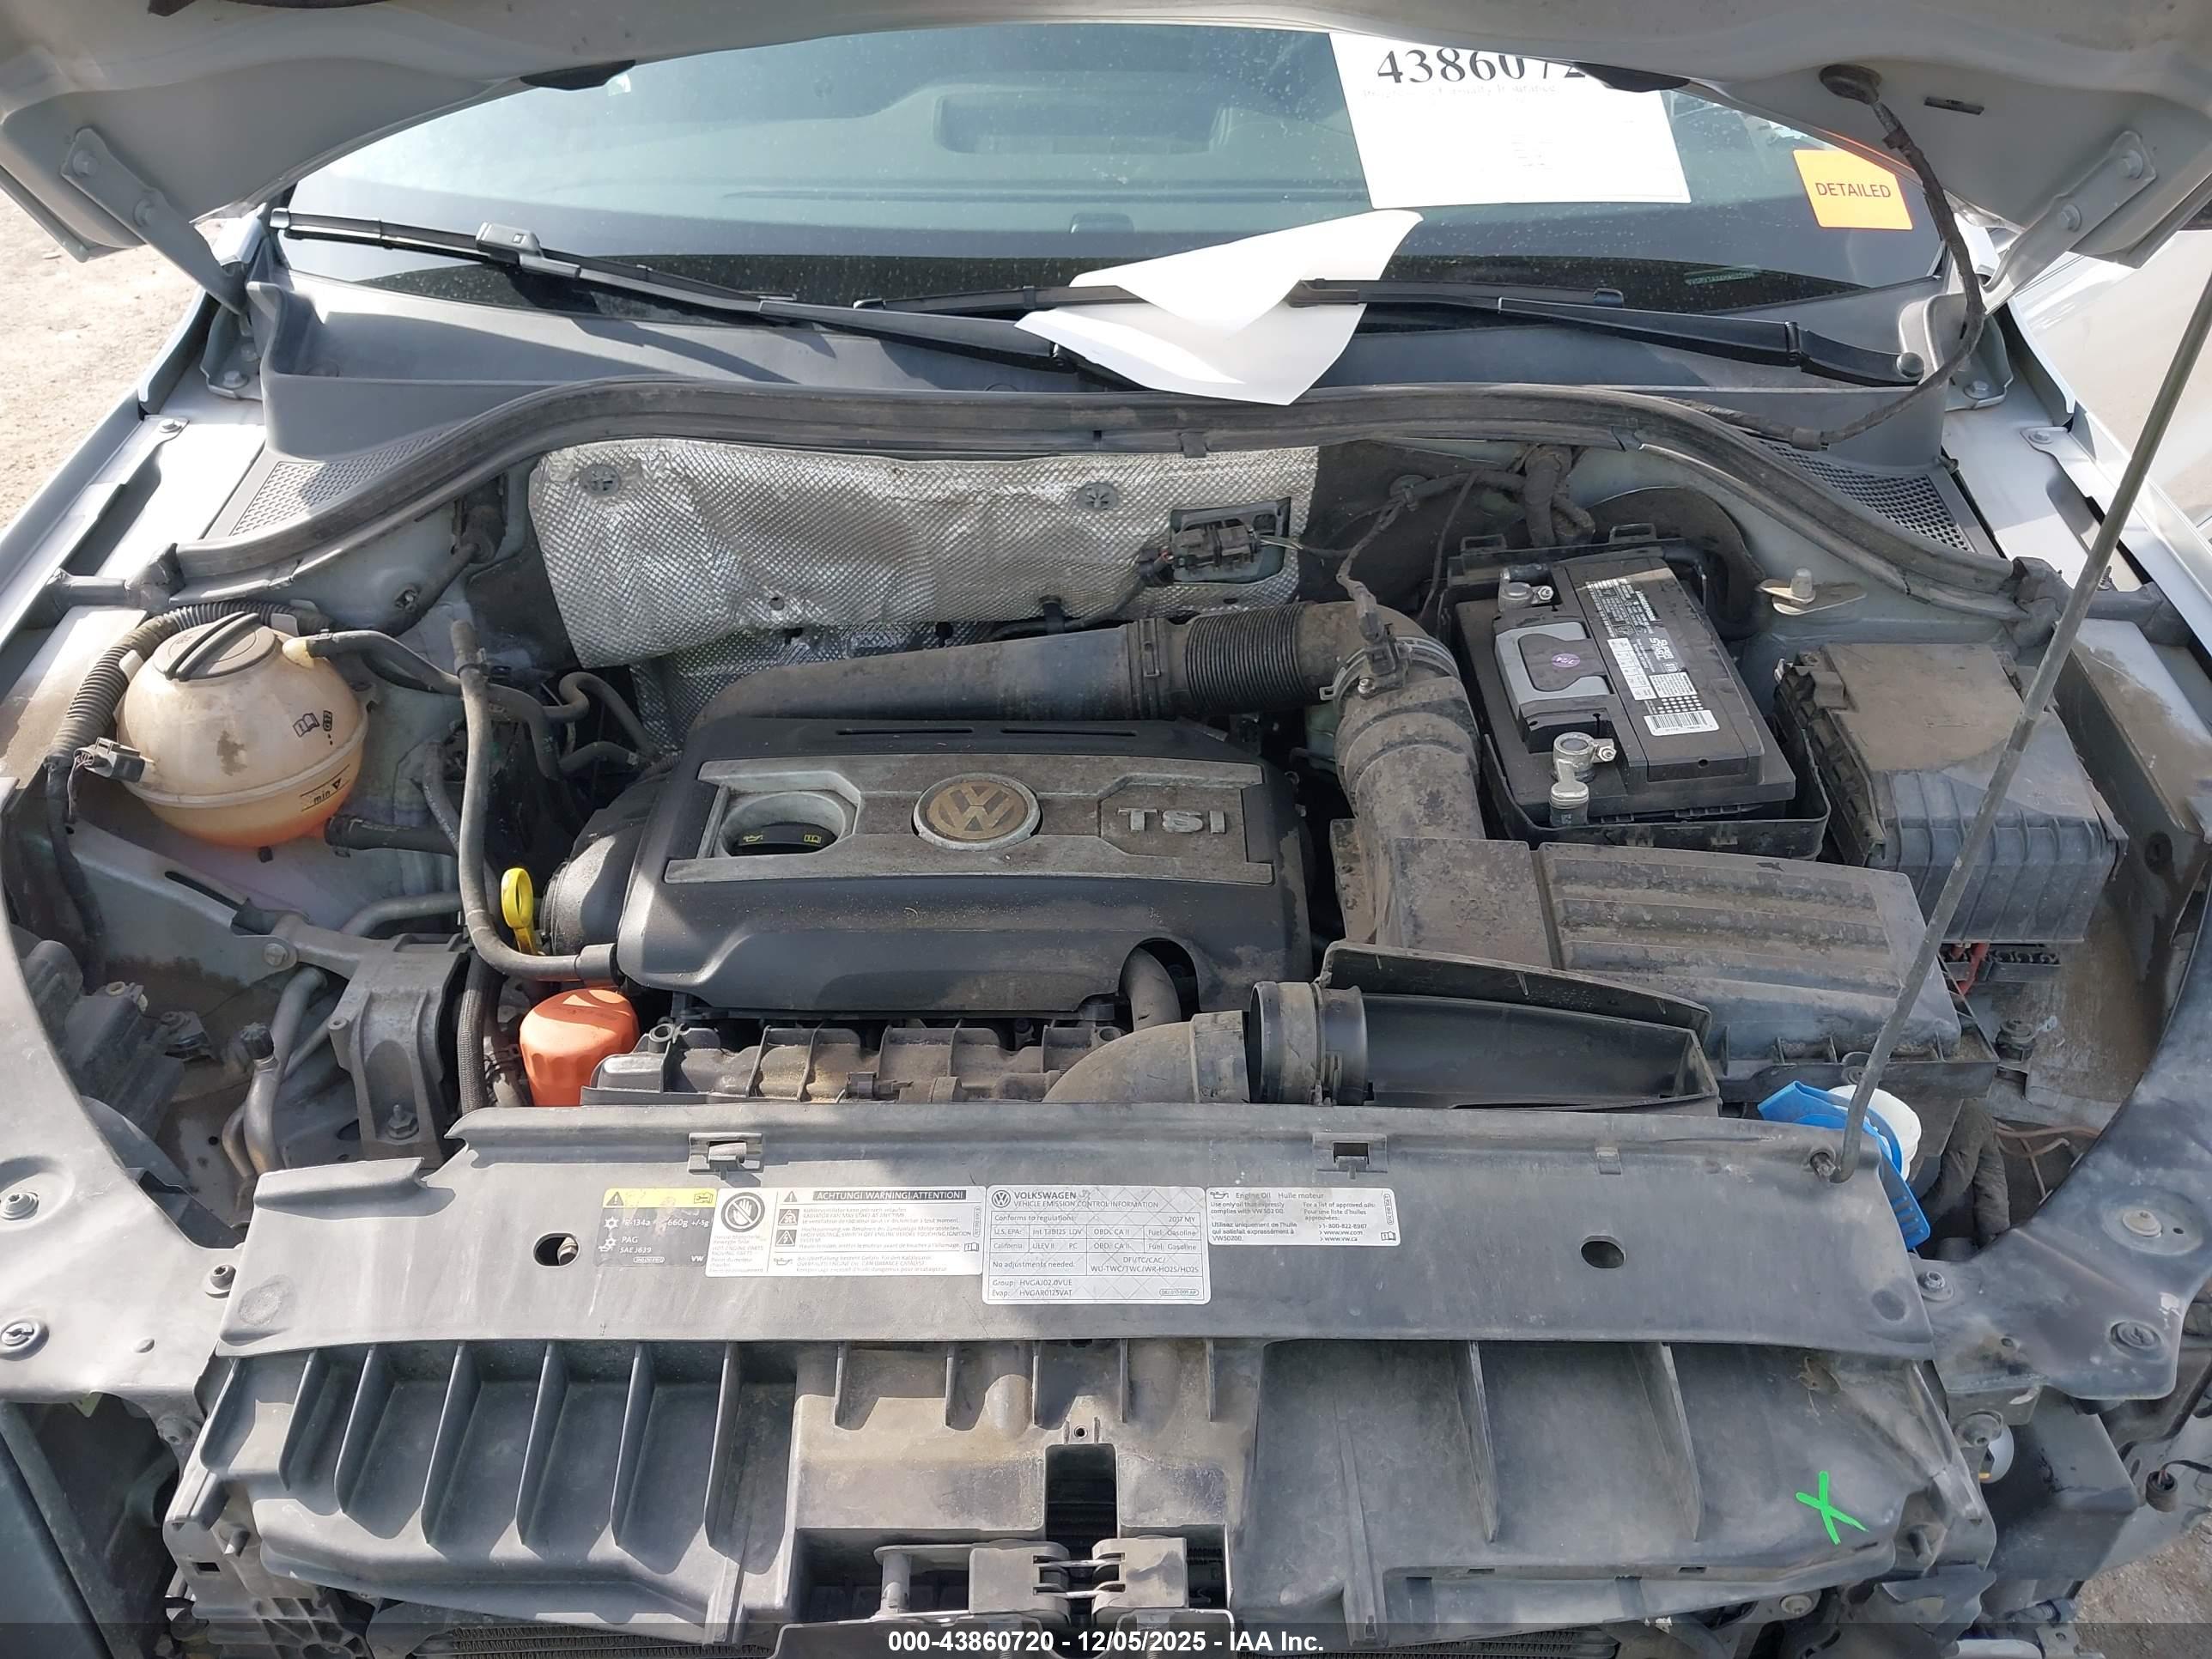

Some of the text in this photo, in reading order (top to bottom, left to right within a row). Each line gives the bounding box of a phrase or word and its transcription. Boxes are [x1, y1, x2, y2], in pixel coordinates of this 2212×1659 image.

[1814, 182, 1892, 198] DETAILED
[313, 790, 331, 805] min
[1116, 807, 1227, 836] TSI
[1014, 1191, 1077, 1200] VOLKSWAGEN
[1236, 1192, 1260, 1200] Engine
[667, 1218, 689, 1228] 660g
[621, 1236, 639, 1244] PAG
[1004, 1261, 1047, 1269] adjustments
